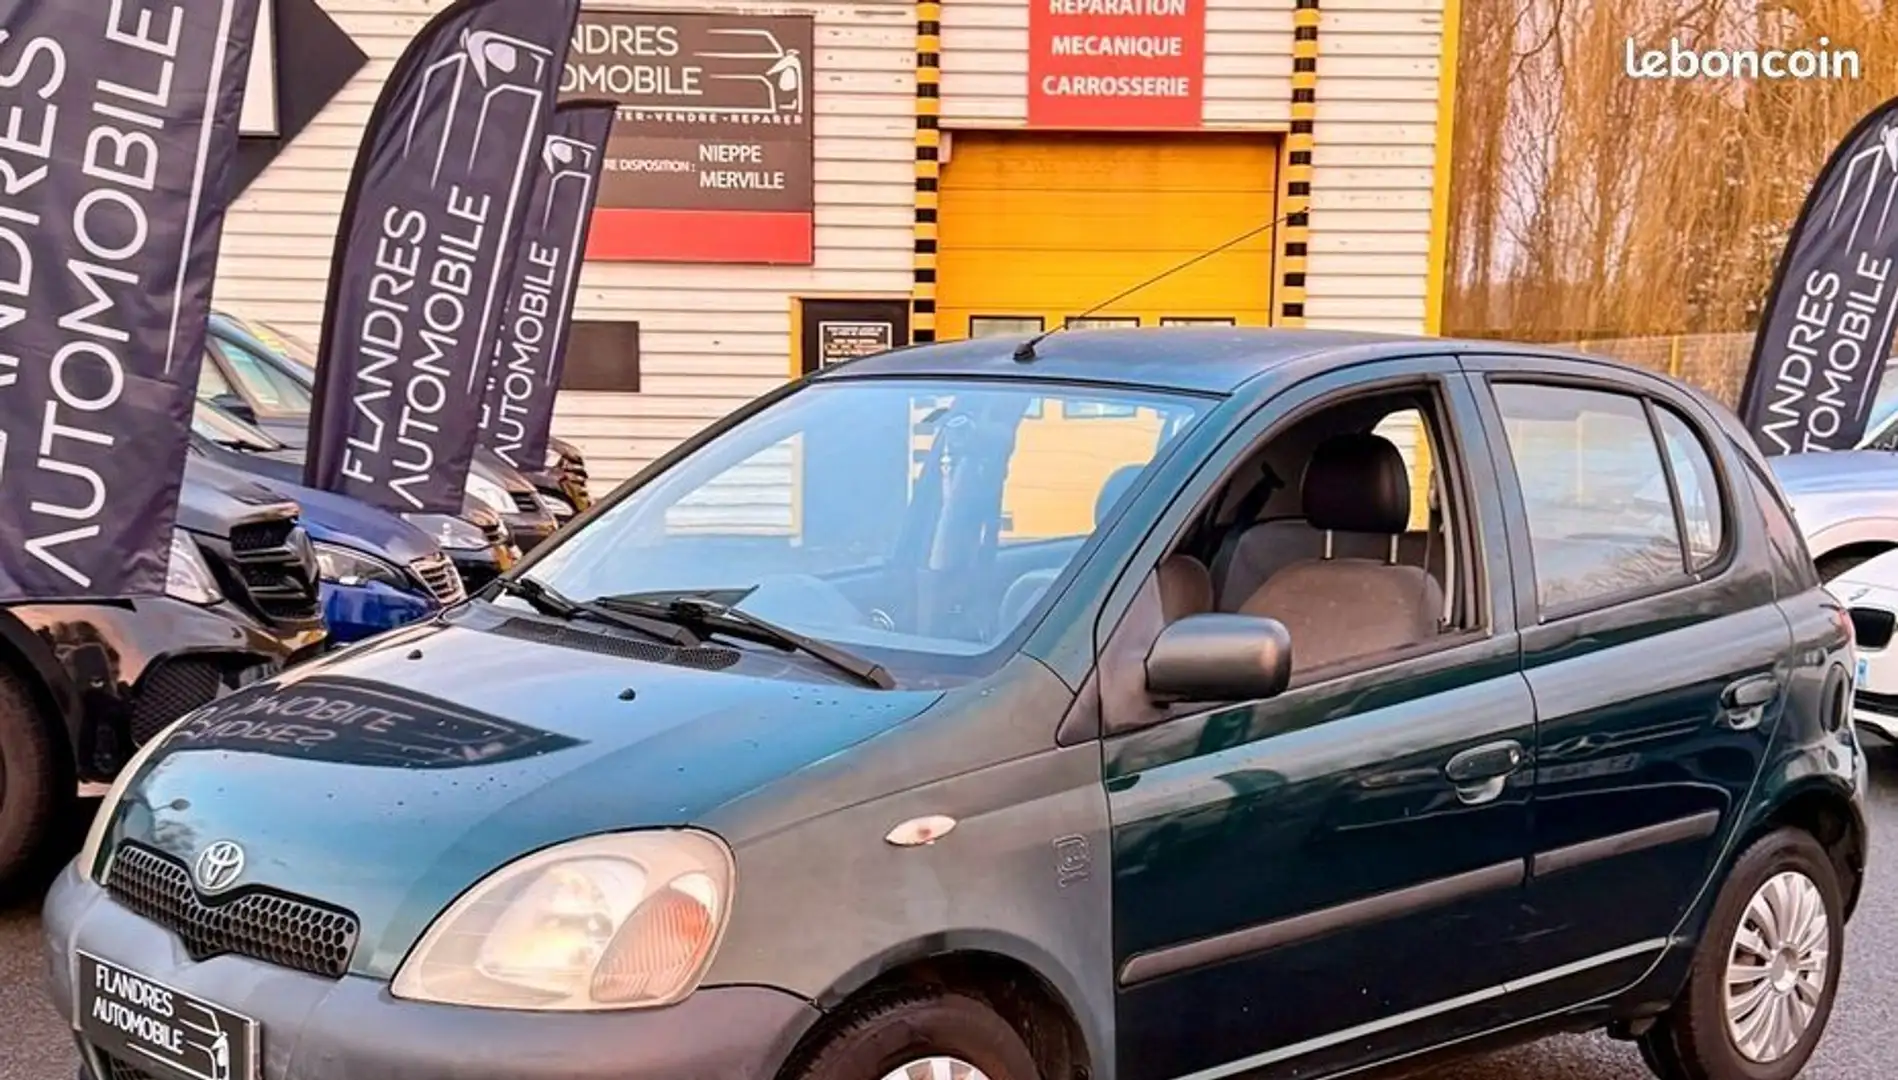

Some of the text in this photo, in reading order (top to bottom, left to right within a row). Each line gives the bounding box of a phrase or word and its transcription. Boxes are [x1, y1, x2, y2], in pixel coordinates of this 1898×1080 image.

[1051, 36, 1183, 57] MECANIQUE
[1042, 75, 1190, 97] CARROSSERIE
[699, 144, 763, 163] NIEPPE
[699, 171, 785, 189] MERVILLE
[24, 3, 183, 588] AUTOMOBILE
[341, 205, 428, 484] FLANDRES
[387, 185, 491, 510] AUTOMOBILE
[494, 241, 560, 469] AUTOMOBILE
[1761, 268, 1841, 456] ANDRES
[95, 963, 175, 1018] FLANDRES
[92, 995, 185, 1056] AUTOMOBILE
